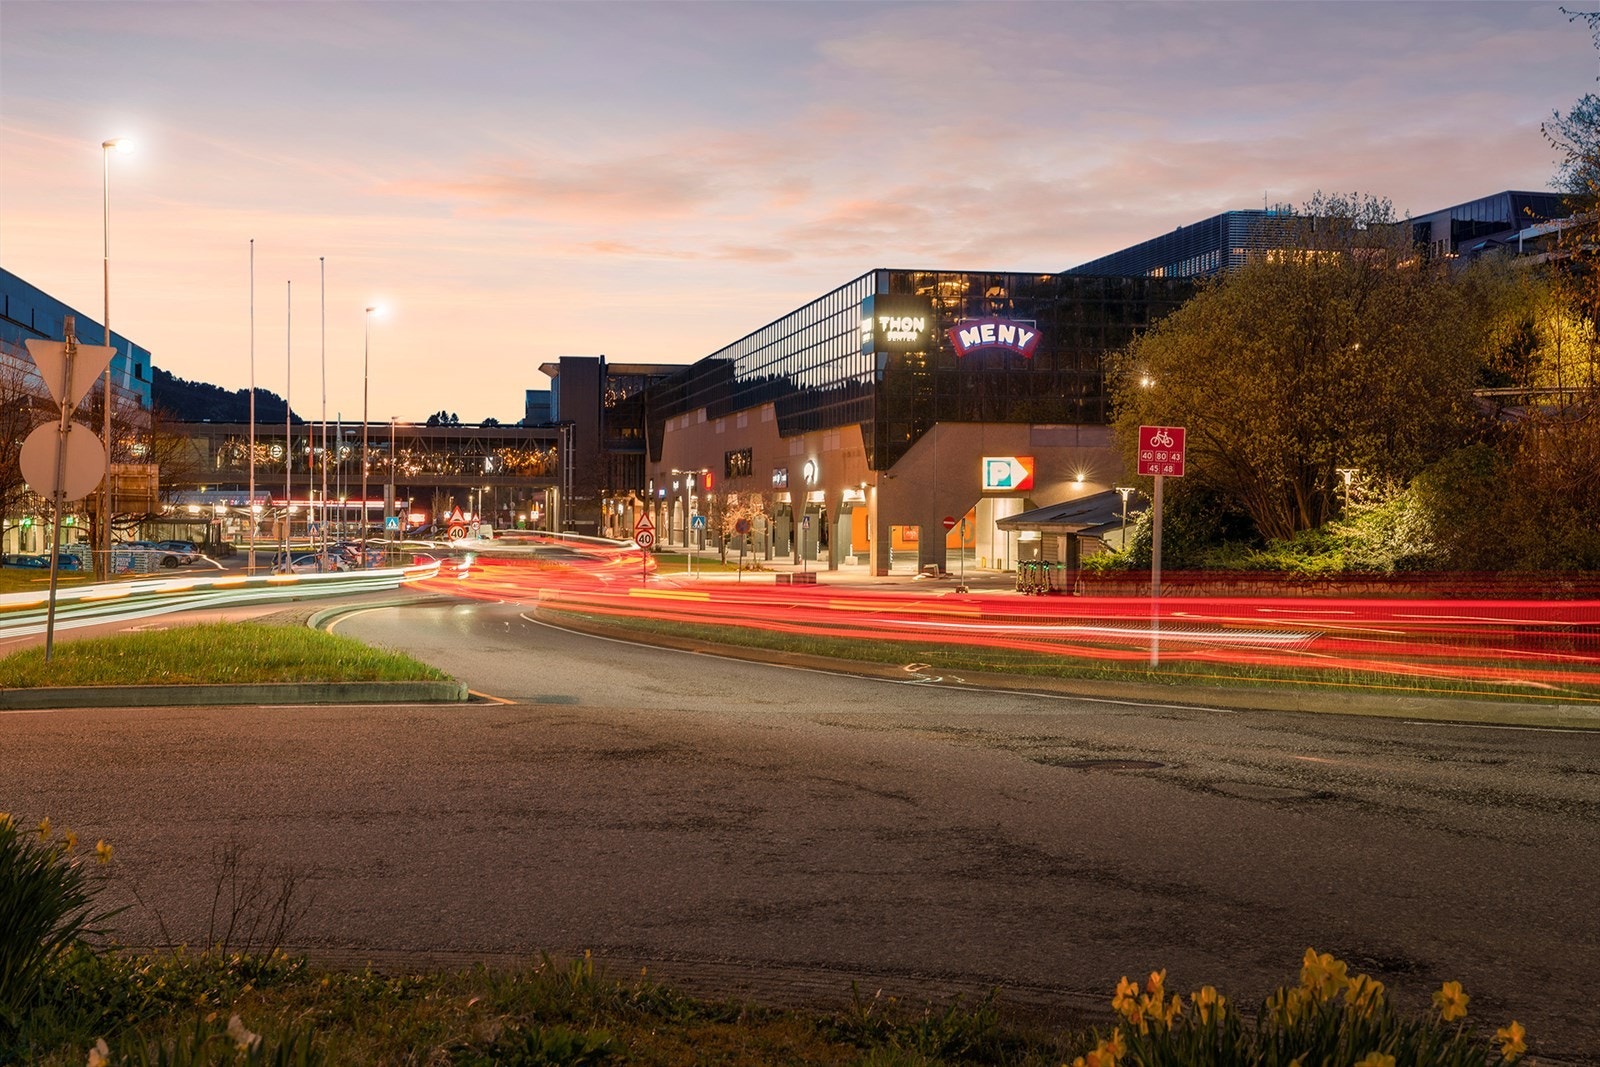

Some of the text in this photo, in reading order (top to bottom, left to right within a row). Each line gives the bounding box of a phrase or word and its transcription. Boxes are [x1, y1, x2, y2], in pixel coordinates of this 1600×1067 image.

[879, 316, 925, 333] THON
[959, 324, 1034, 349] MENY
[1141, 452, 1181, 461] 40 80 43
[989, 462, 1011, 486] P
[1149, 465, 1173, 473] 45 48
[451, 528, 464, 538] 40
[638, 534, 651, 544] 40
